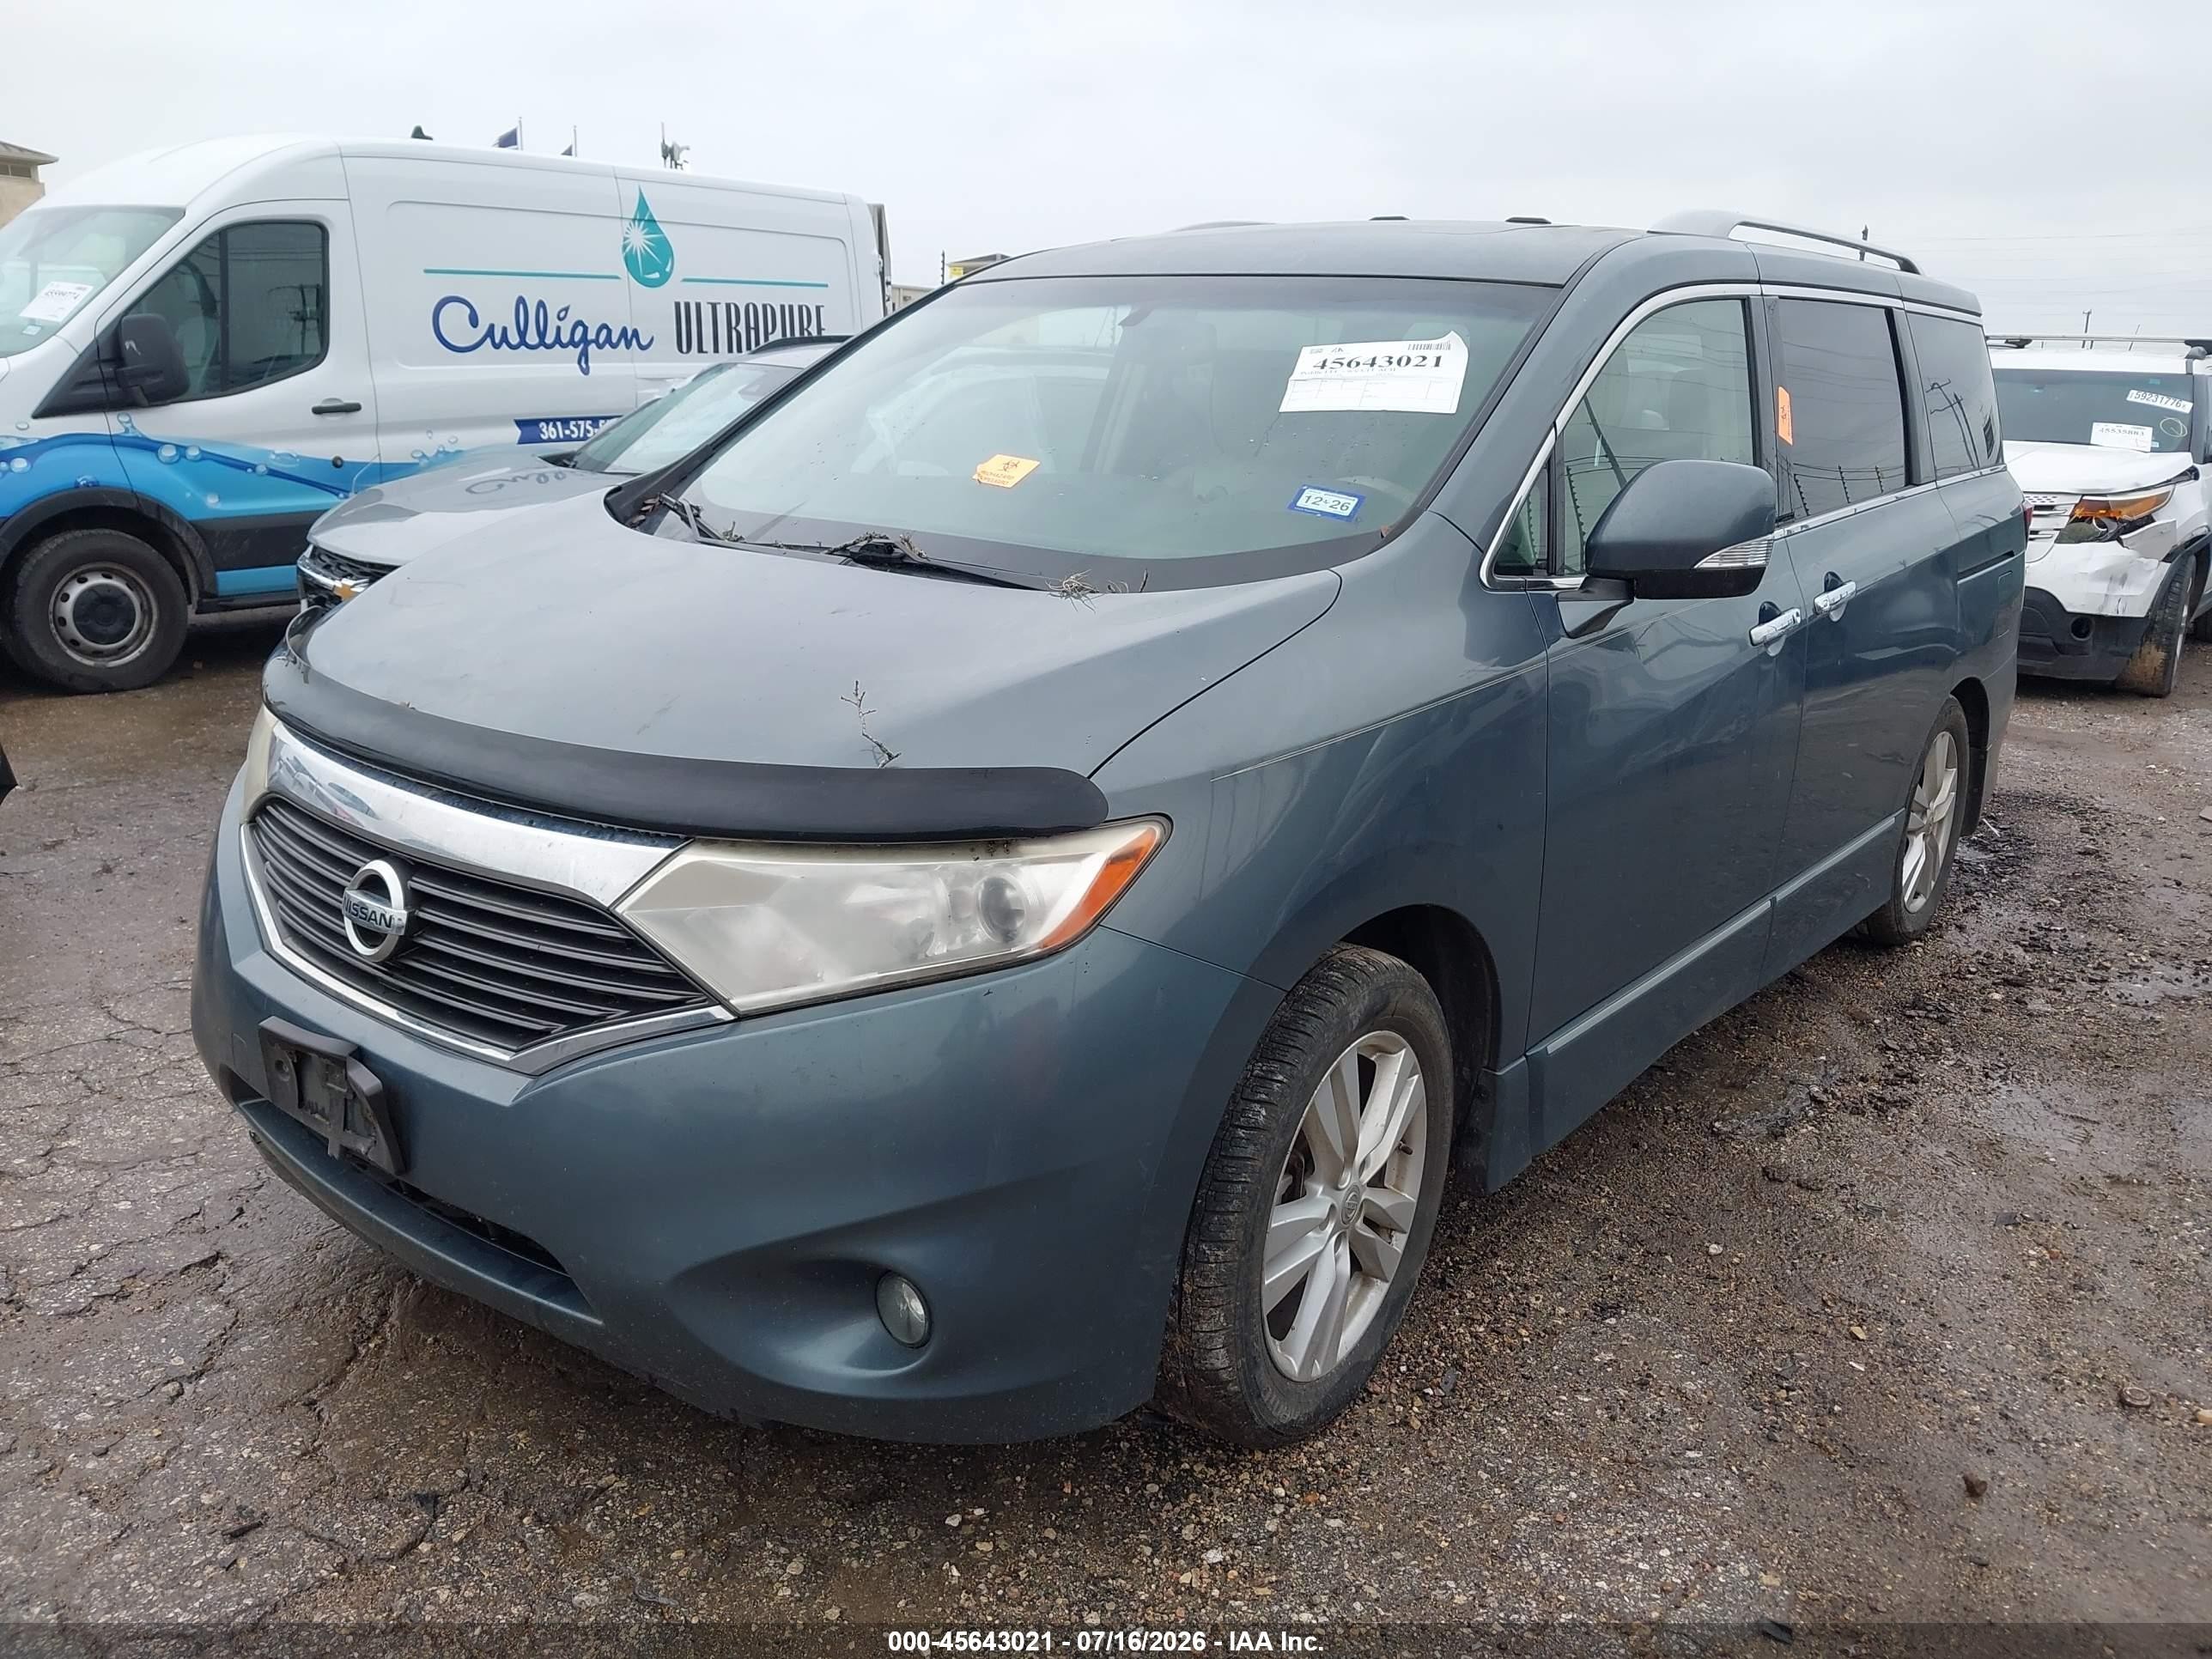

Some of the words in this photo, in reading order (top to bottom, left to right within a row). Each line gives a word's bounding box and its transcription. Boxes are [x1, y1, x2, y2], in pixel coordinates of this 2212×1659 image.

[432, 295, 654, 375] Culligan
[674, 301, 825, 355] ULTRAPURE
[1313, 355, 1443, 369] 45643021
[2135, 391, 2182, 408] 59231776
[1304, 495, 1323, 506] 12
[1328, 500, 1351, 512] 26
[343, 893, 393, 928] NISSAN
